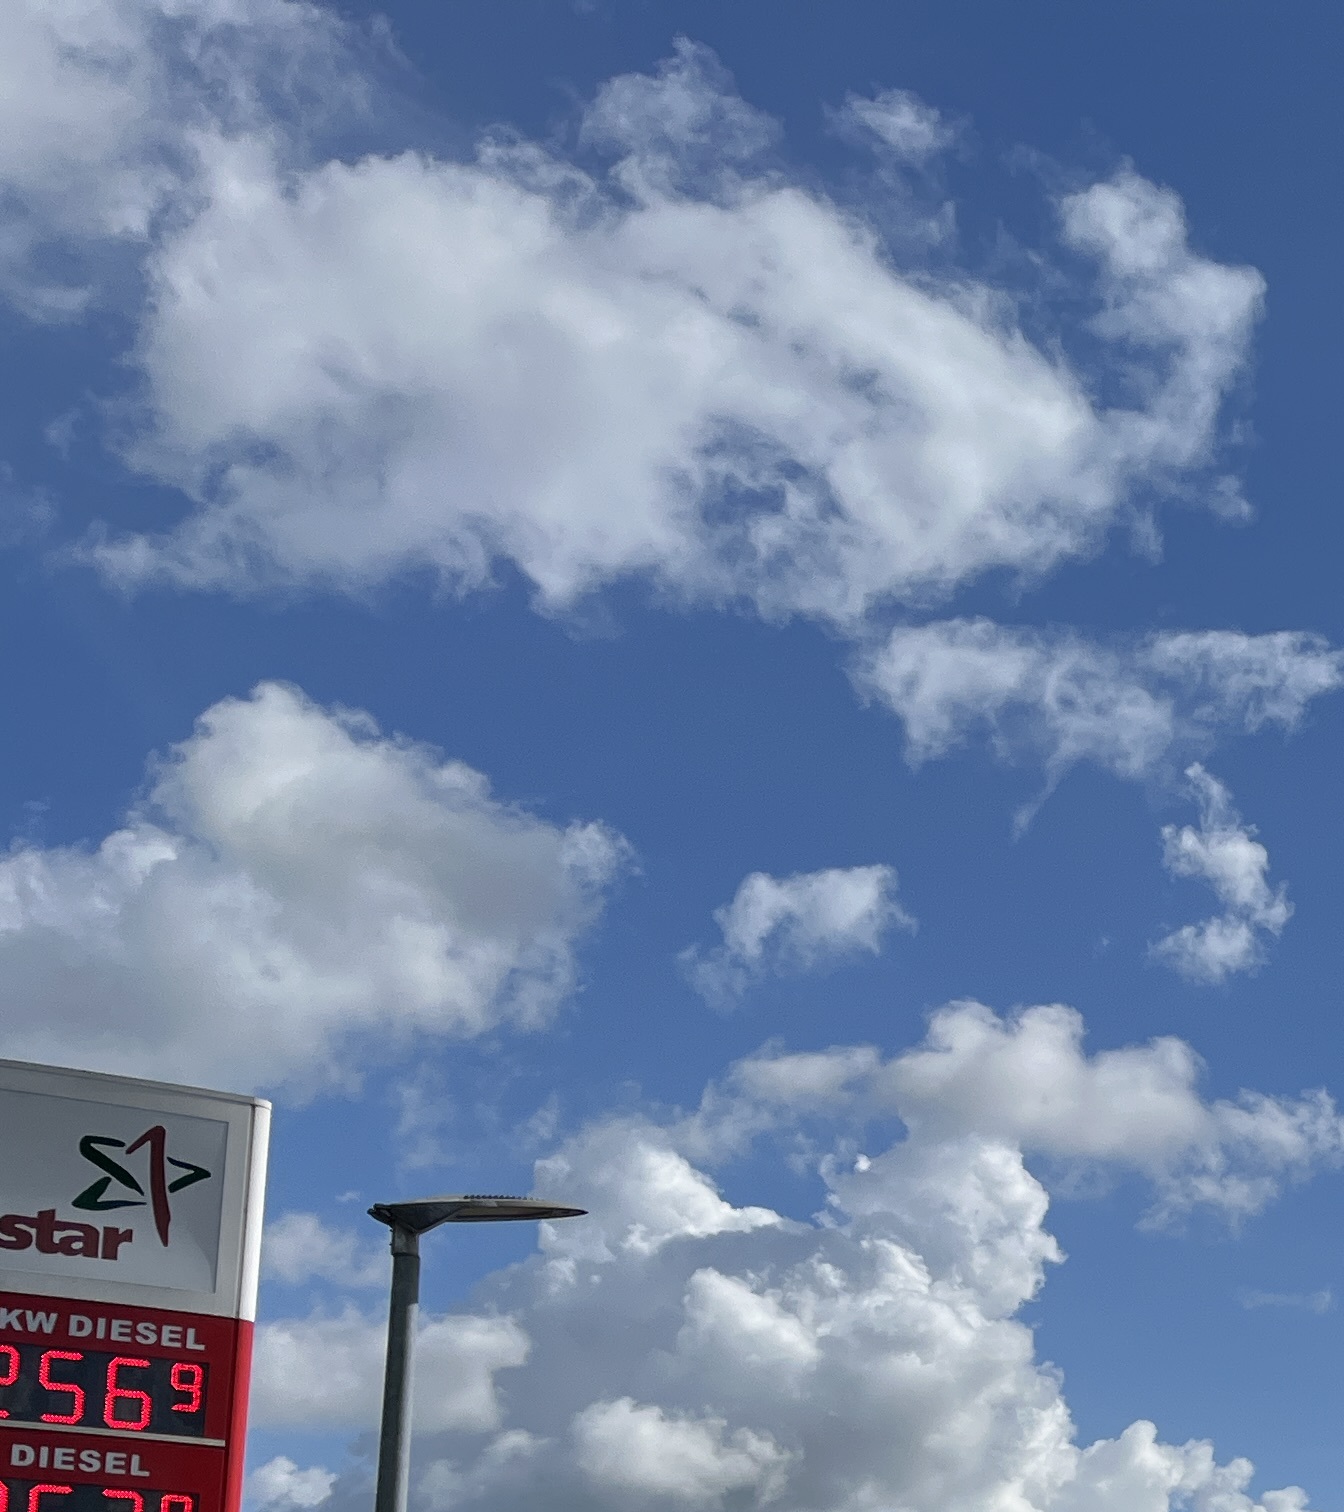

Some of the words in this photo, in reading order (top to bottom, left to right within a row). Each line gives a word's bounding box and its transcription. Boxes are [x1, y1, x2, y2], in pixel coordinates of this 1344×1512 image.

[0, 1209, 133, 1260] star
[68, 1314, 205, 1351] DIESEL
[10, 1443, 150, 1477] DIESEL
